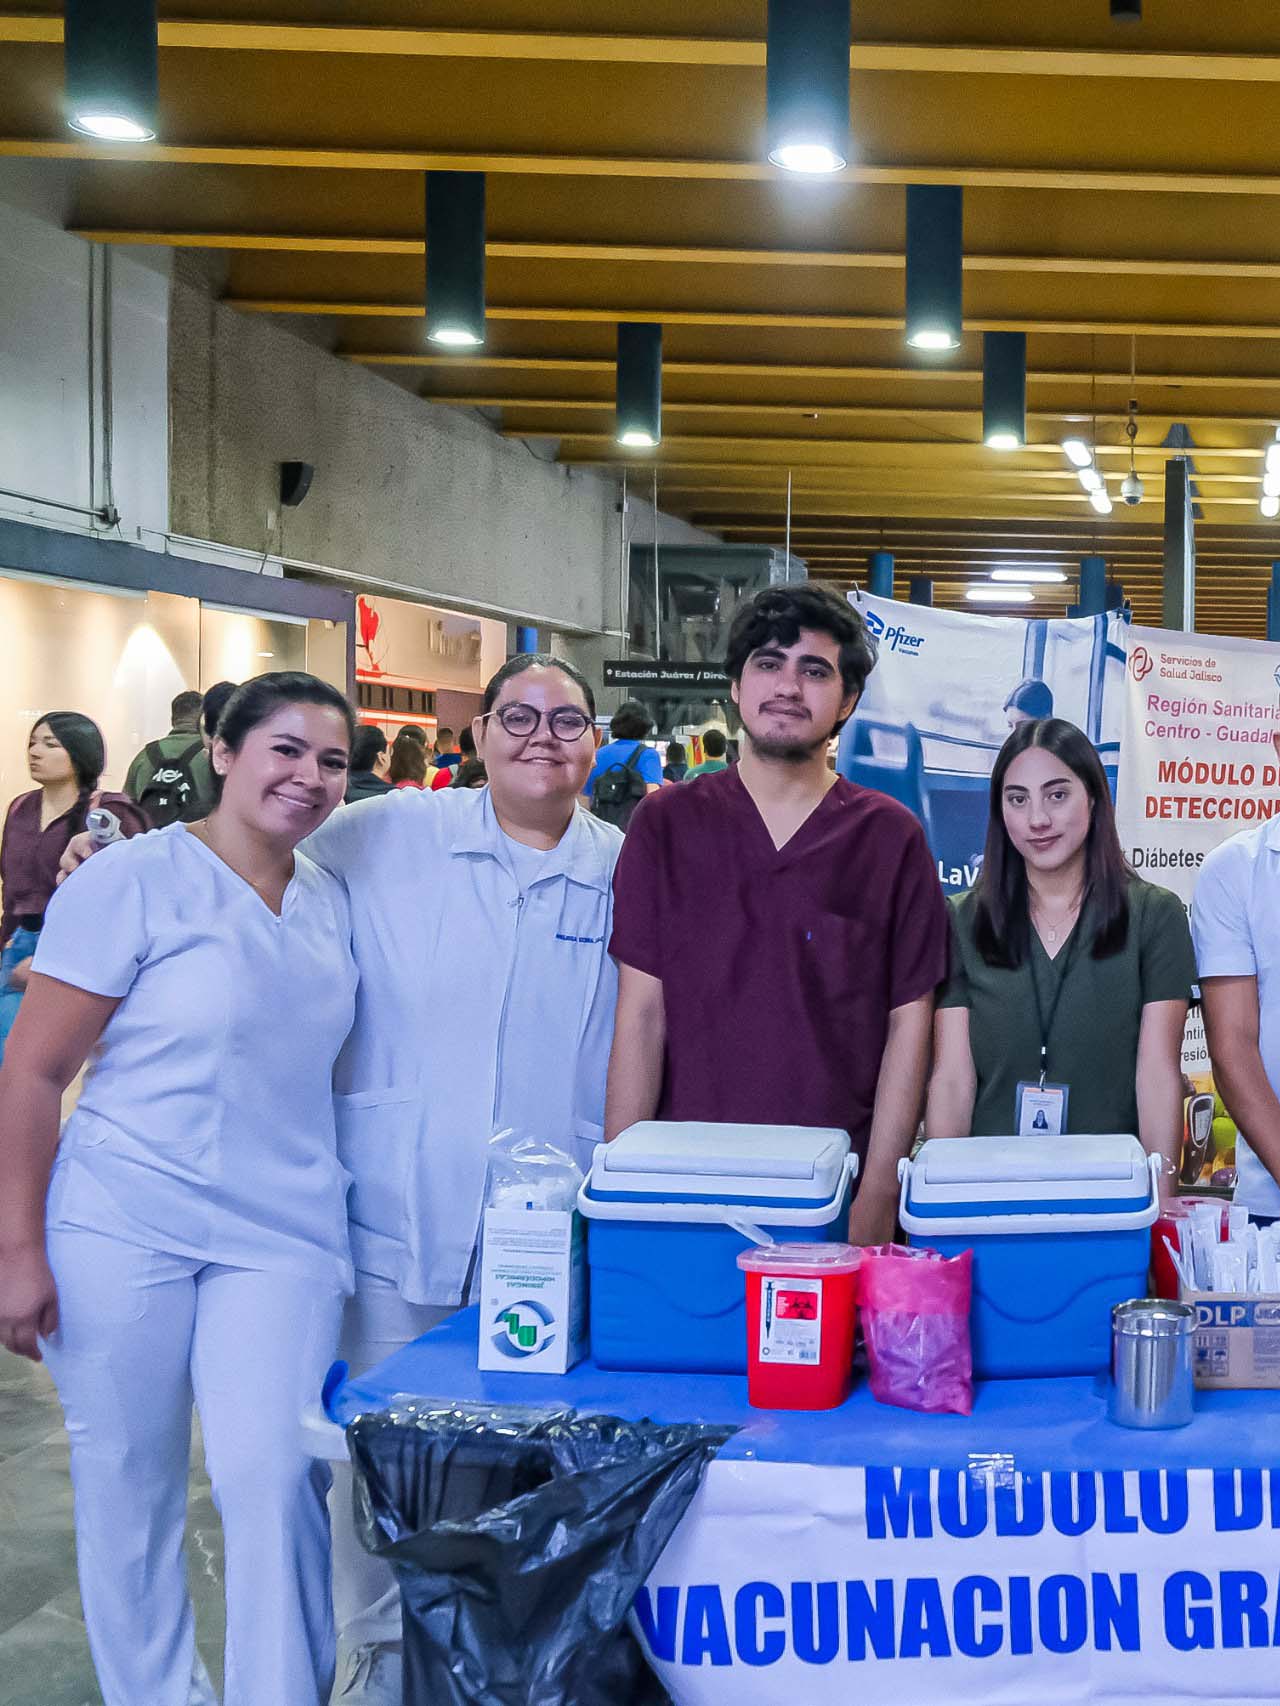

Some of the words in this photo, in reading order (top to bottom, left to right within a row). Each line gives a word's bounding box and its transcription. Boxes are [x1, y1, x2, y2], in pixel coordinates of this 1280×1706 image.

[884, 626, 925, 651] Pfizer
[1160, 653, 1203, 668] Servicios
[1205, 657, 1217, 668] de
[615, 670, 658, 678] Estación
[660, 670, 695, 679] Juárez
[1160, 667, 1187, 680] Salud
[1189, 669, 1222, 682] Jalisco
[1147, 694, 1207, 717] Región
[1144, 720, 1200, 740] Centro
[1216, 725, 1274, 744] Guadal
[1158, 756, 1255, 786] MÓDULO
[1132, 847, 1205, 869] Diábetes
[1197, 1305, 1246, 1325] DLP
[640, 1573, 1141, 1667] VACUNACION
